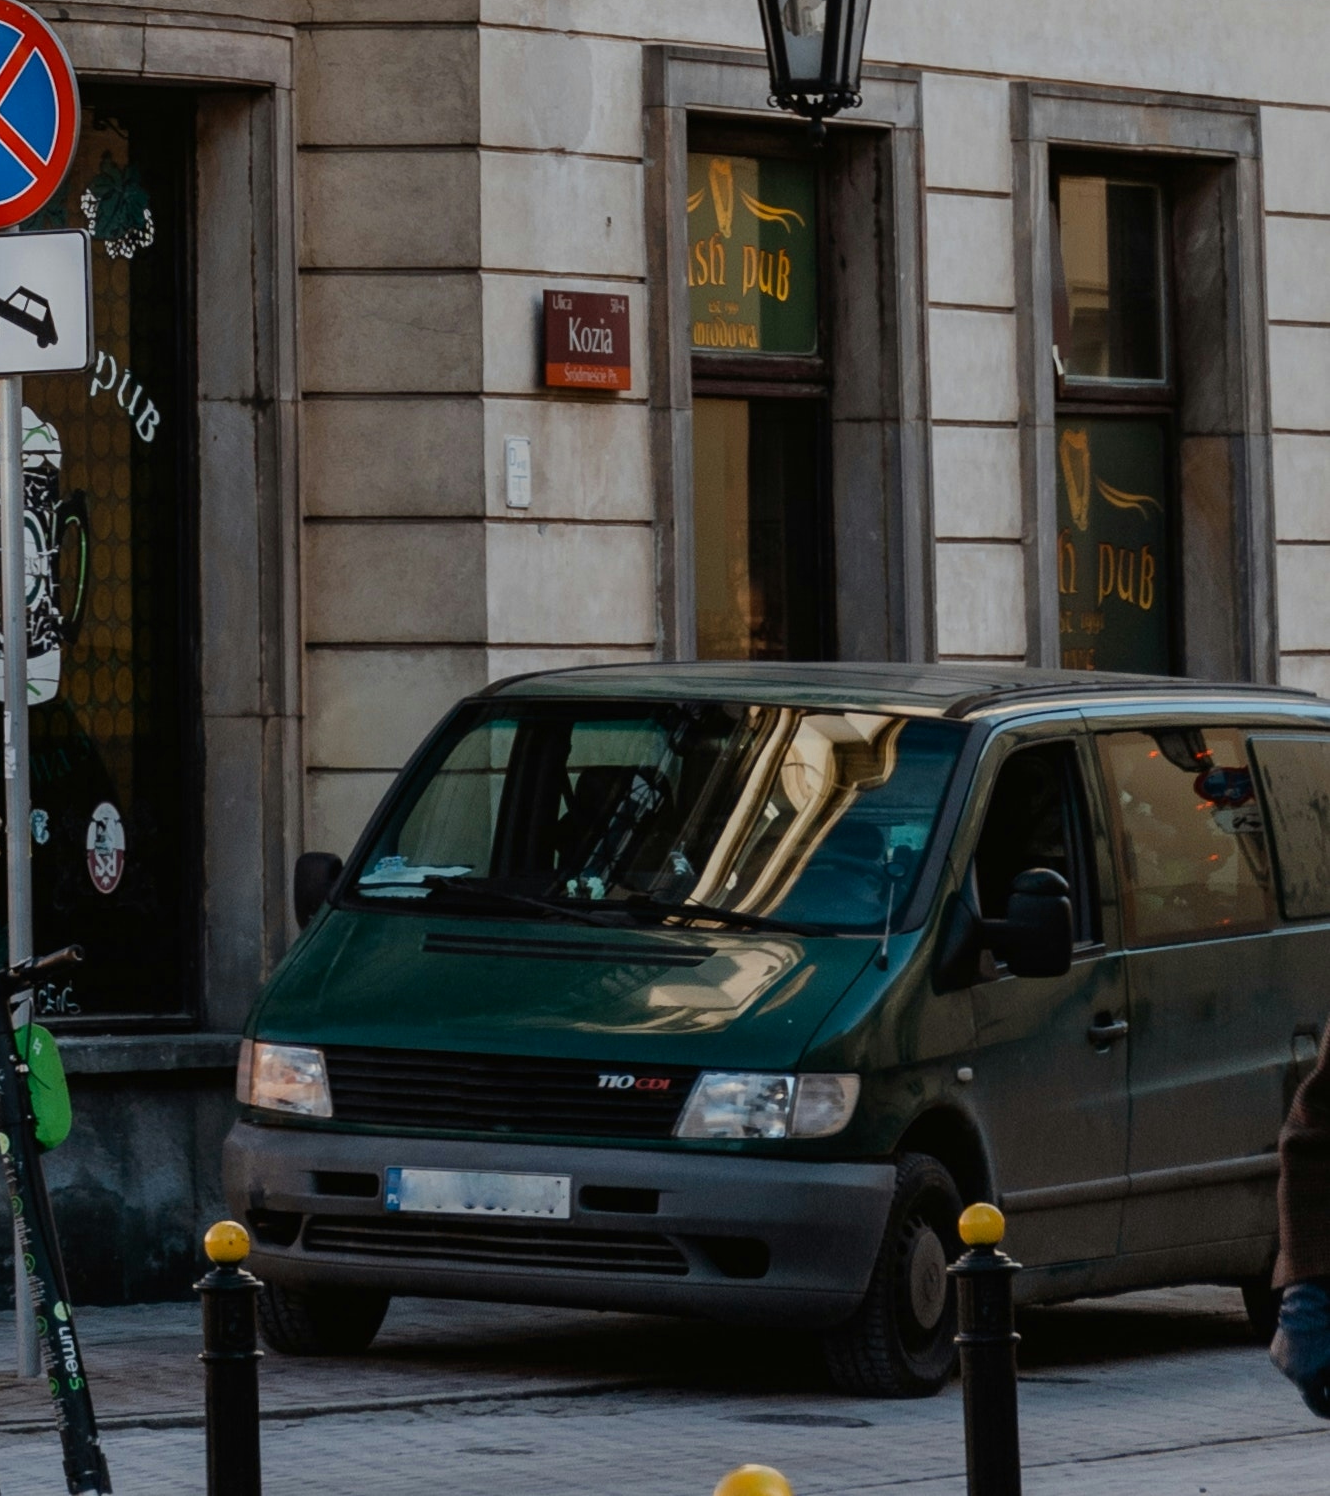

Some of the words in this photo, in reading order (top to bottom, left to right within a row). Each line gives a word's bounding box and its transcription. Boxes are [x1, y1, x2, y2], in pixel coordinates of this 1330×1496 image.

[552, 294, 573, 310] Ulica
[568, 316, 613, 354] Kozia
[635, 1078, 671, 1090] CDI
